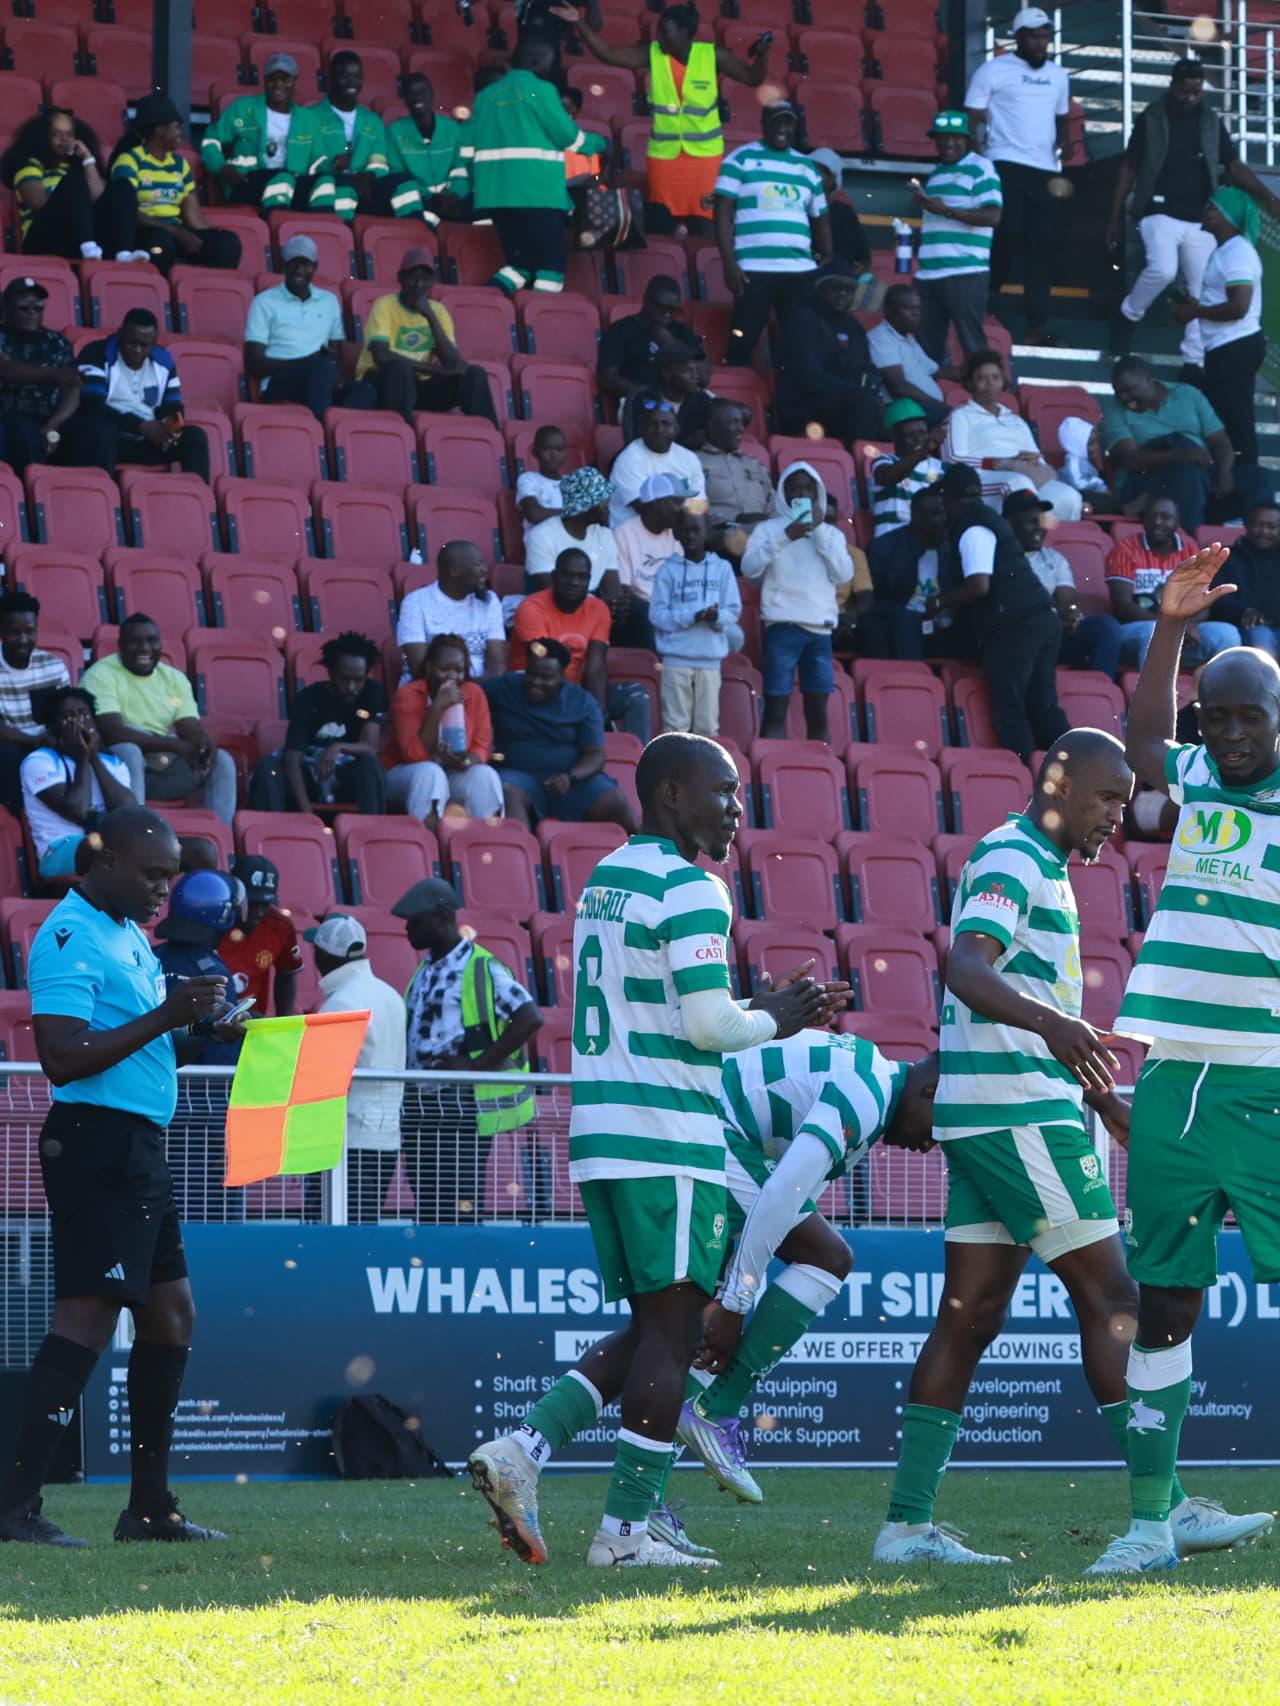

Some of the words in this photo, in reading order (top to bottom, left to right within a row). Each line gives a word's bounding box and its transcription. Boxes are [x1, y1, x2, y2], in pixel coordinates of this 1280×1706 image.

[1195, 857, 1254, 882] METAL
[804, 1340, 836, 1359] WE
[841, 1340, 904, 1359] OFFER
[493, 1376, 537, 1392] Shaft
[756, 1376, 837, 1398] Equipping
[967, 1377, 1062, 1398] evelopment
[753, 1402, 824, 1423] Planning
[963, 1402, 1049, 1423] ngineering
[753, 1427, 792, 1442] Rock
[796, 1427, 861, 1448] Support
[956, 1427, 1042, 1443] Production
